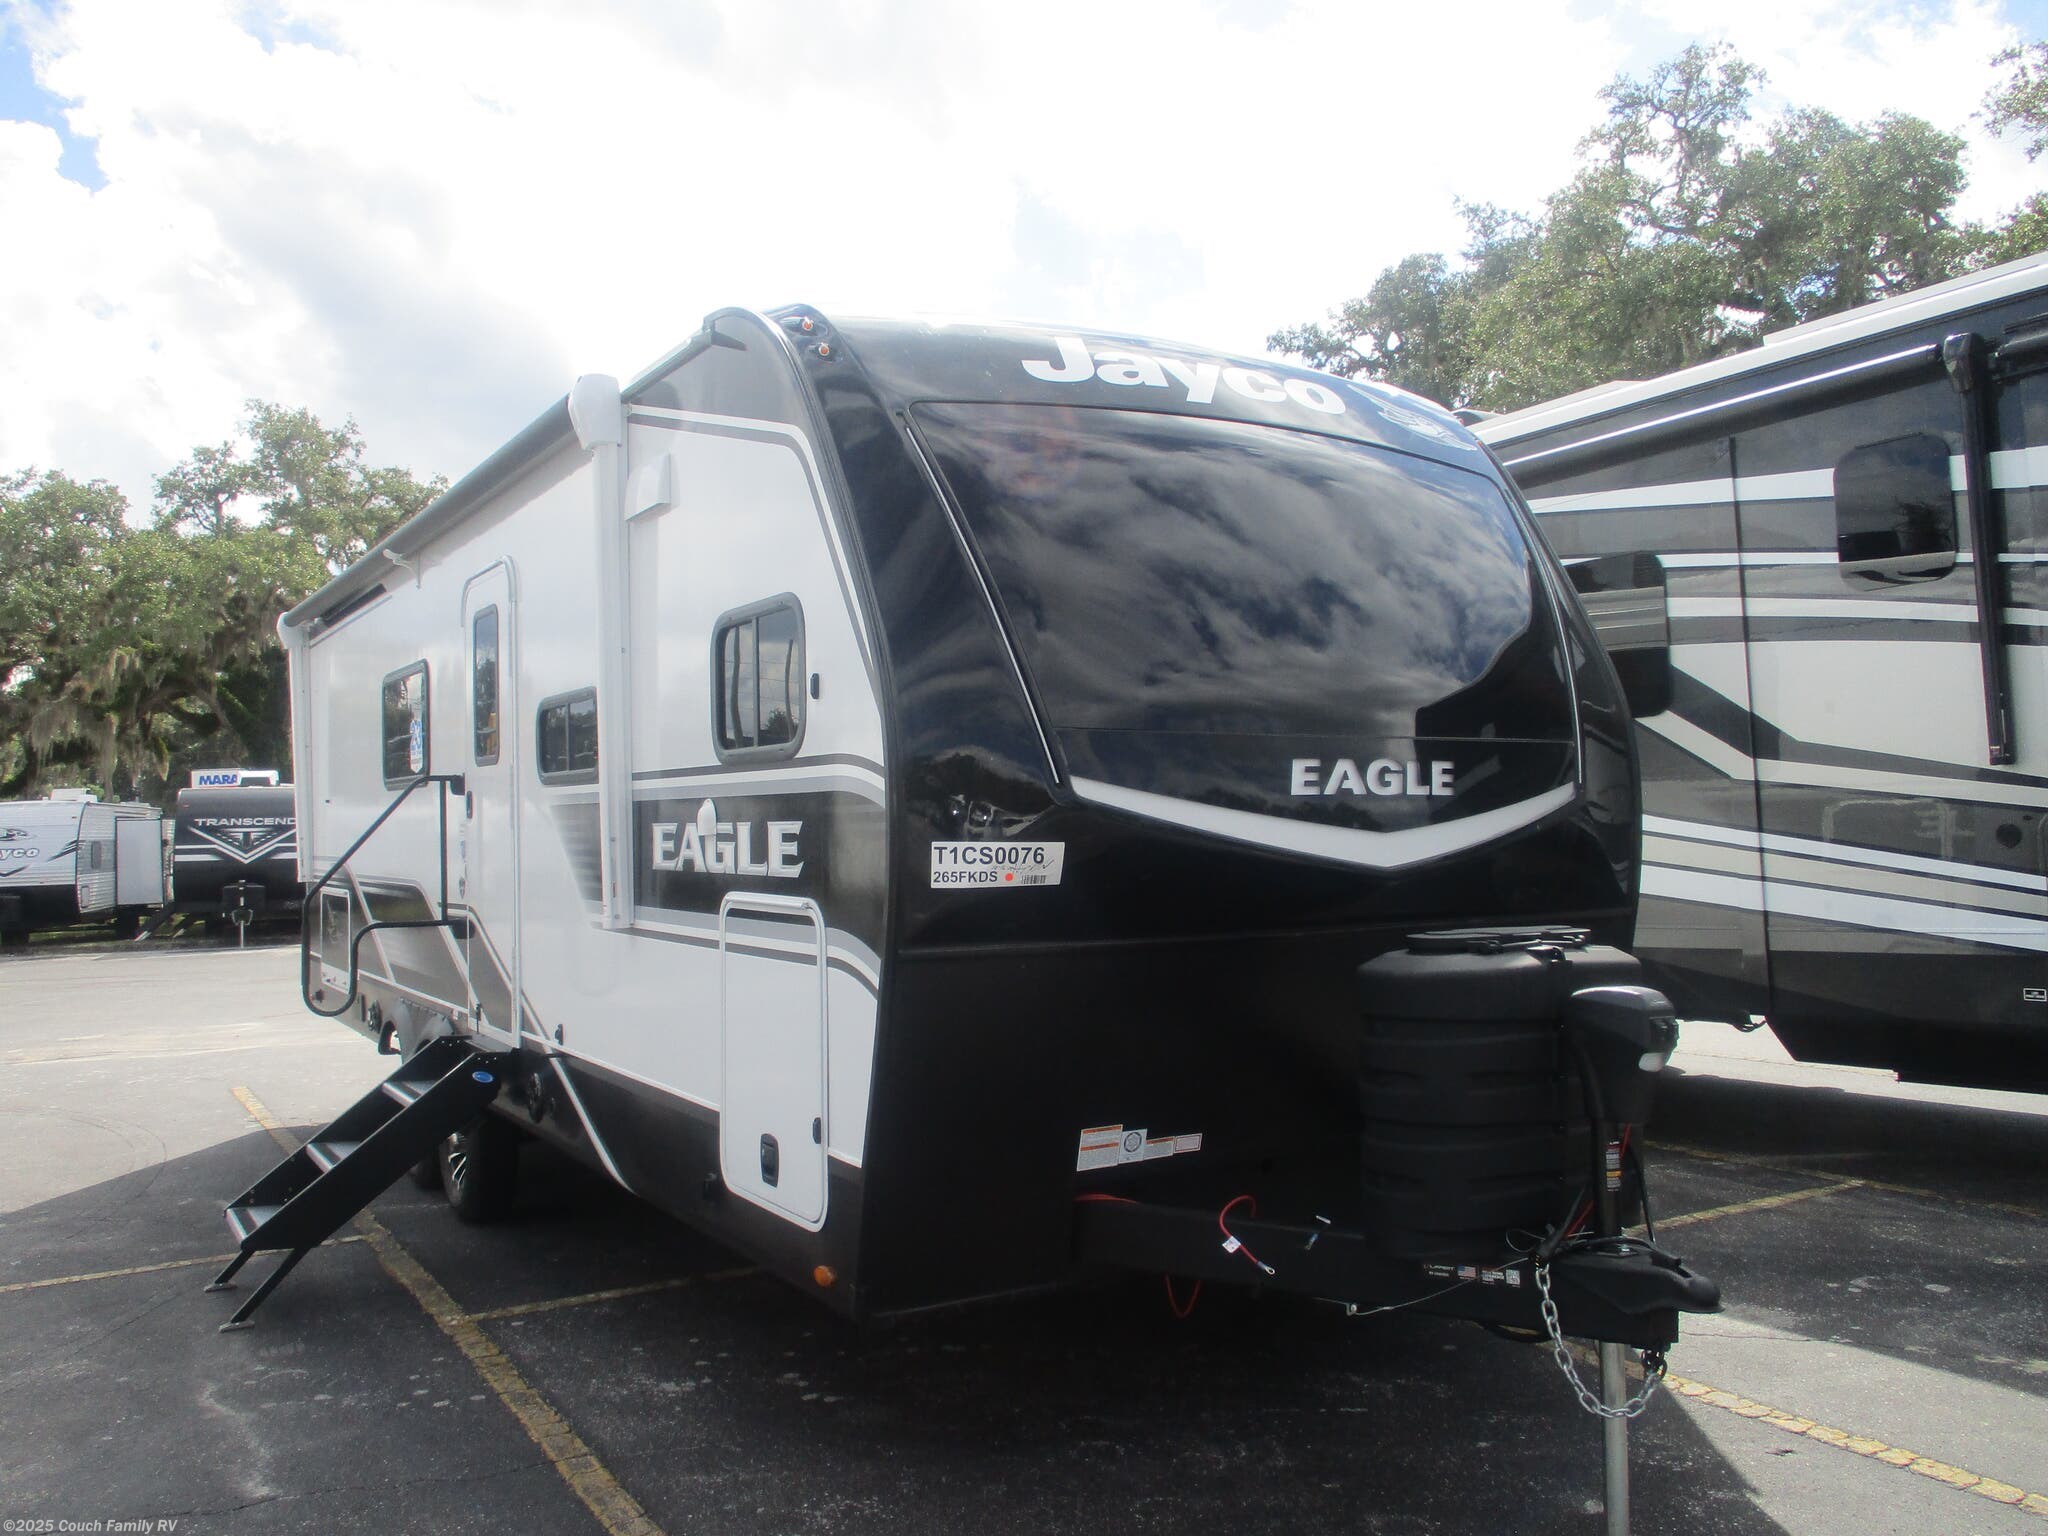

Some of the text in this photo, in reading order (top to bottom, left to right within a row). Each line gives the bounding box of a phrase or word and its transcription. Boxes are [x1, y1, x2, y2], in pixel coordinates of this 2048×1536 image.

[1021, 335, 1346, 415] Jayco
[1290, 757, 1456, 796] EAGLE
[0, 847, 40, 861] yco
[651, 820, 805, 878] EAGLE
[933, 846, 1046, 865] T1CS0076
[932, 870, 999, 883] 265FKDS
